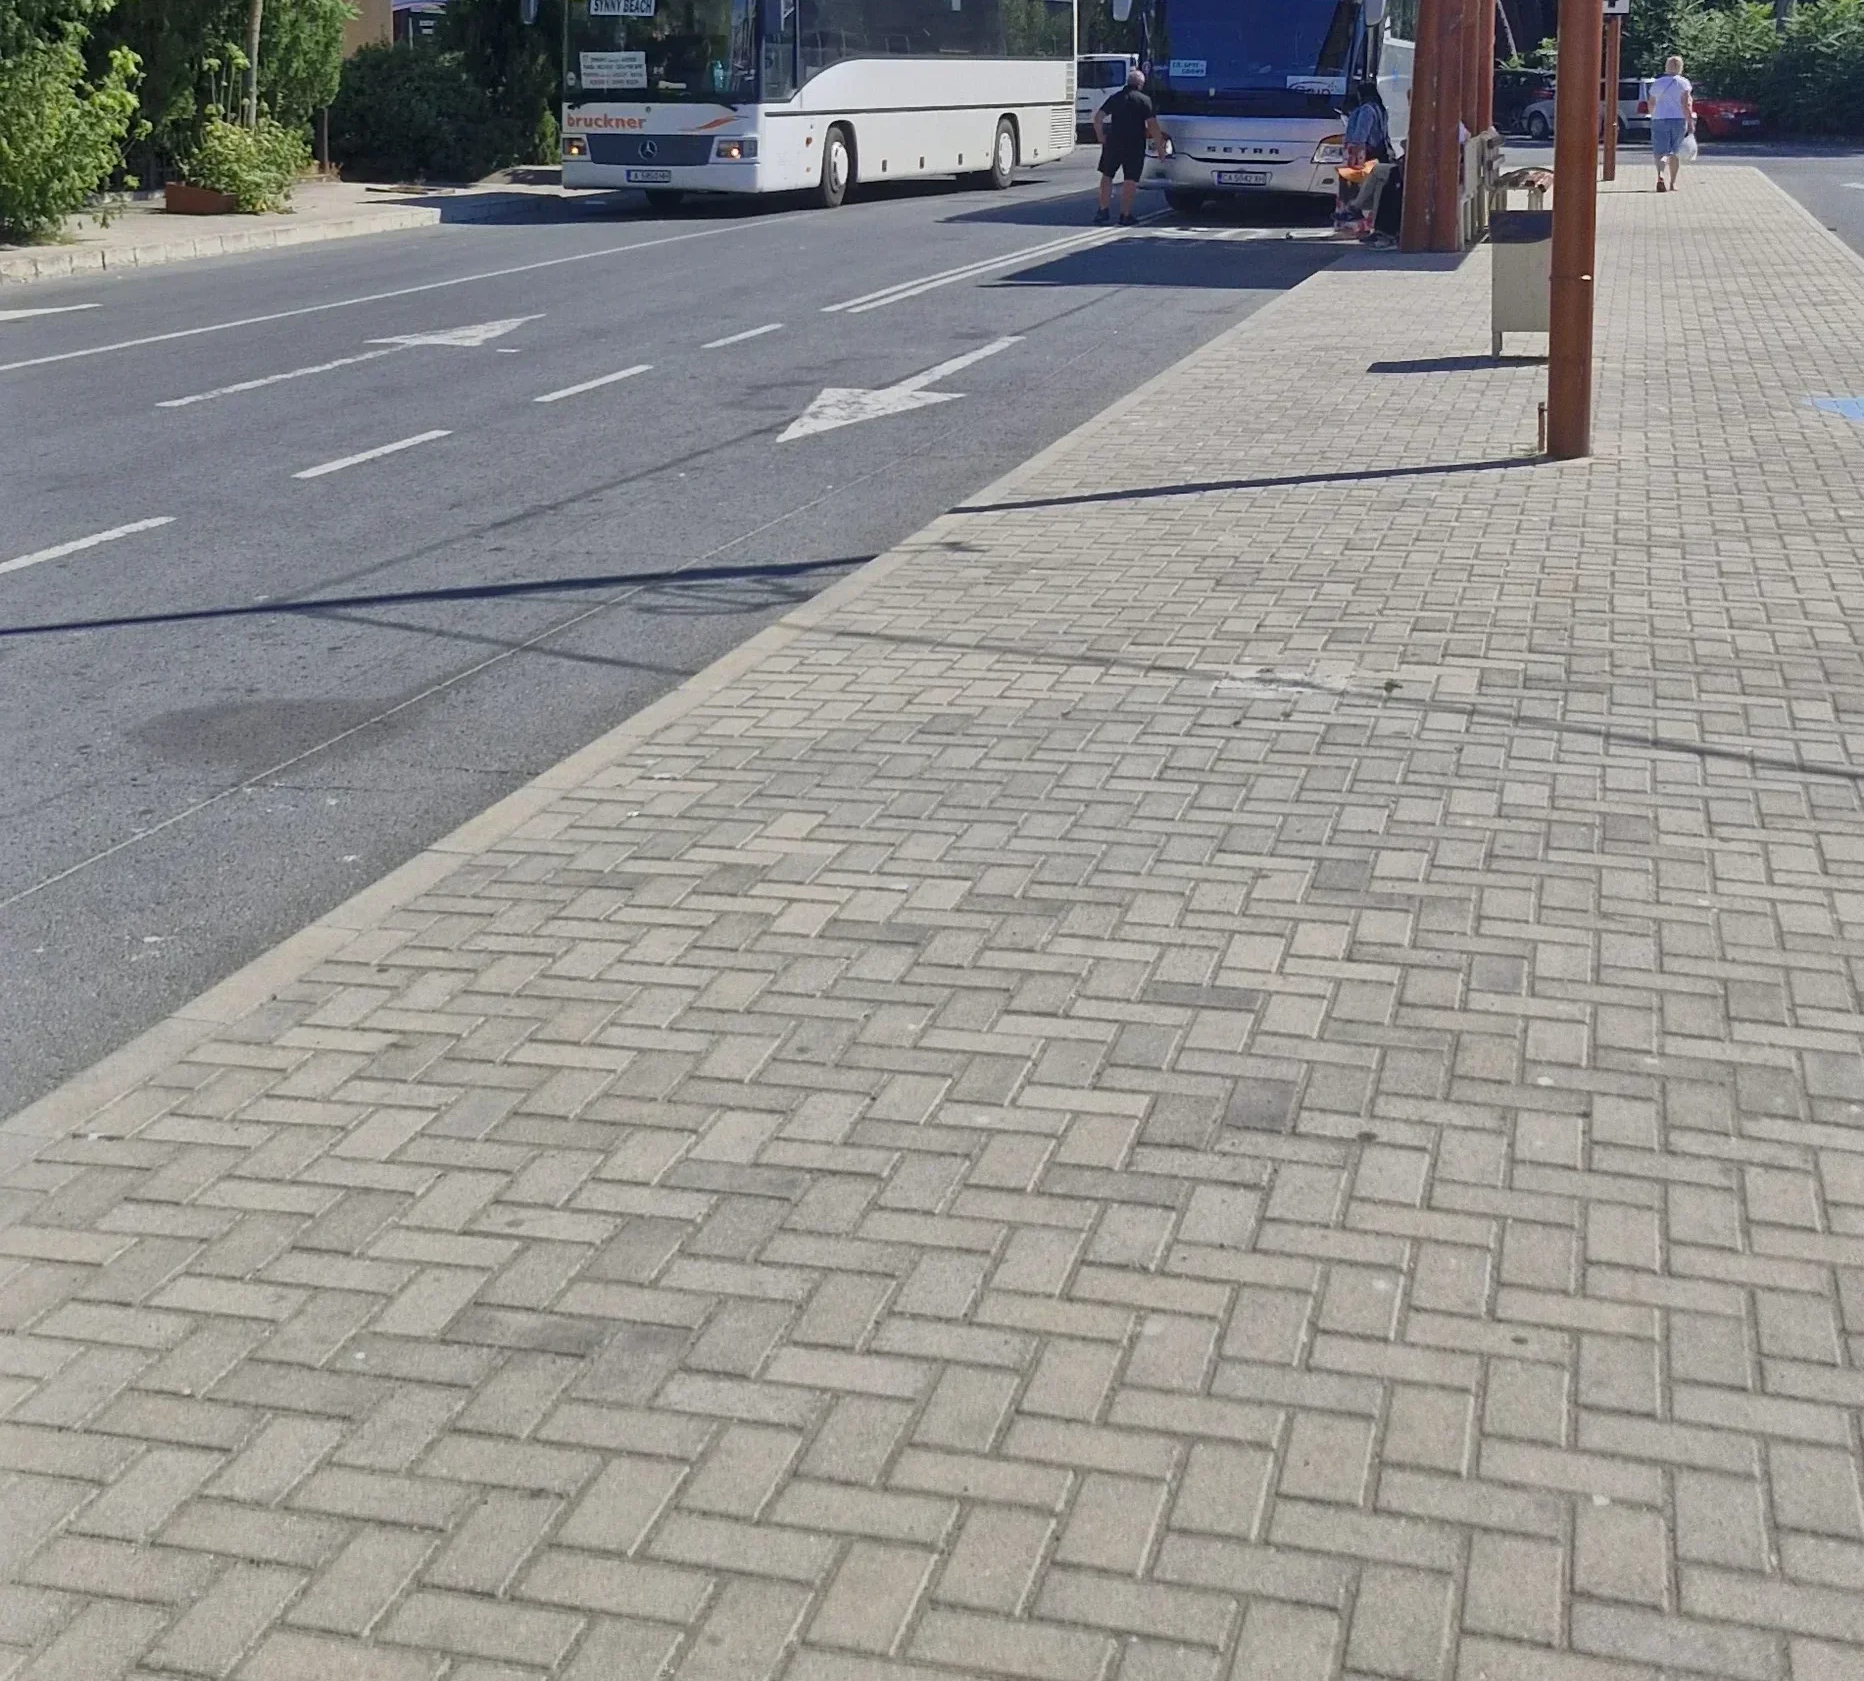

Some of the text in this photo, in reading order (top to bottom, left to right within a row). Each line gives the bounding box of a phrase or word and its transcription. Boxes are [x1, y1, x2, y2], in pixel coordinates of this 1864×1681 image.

[623, 0, 652, 13] BEACH
[567, 113, 646, 129] bruckner
[1207, 146, 1279, 154] SETRA
